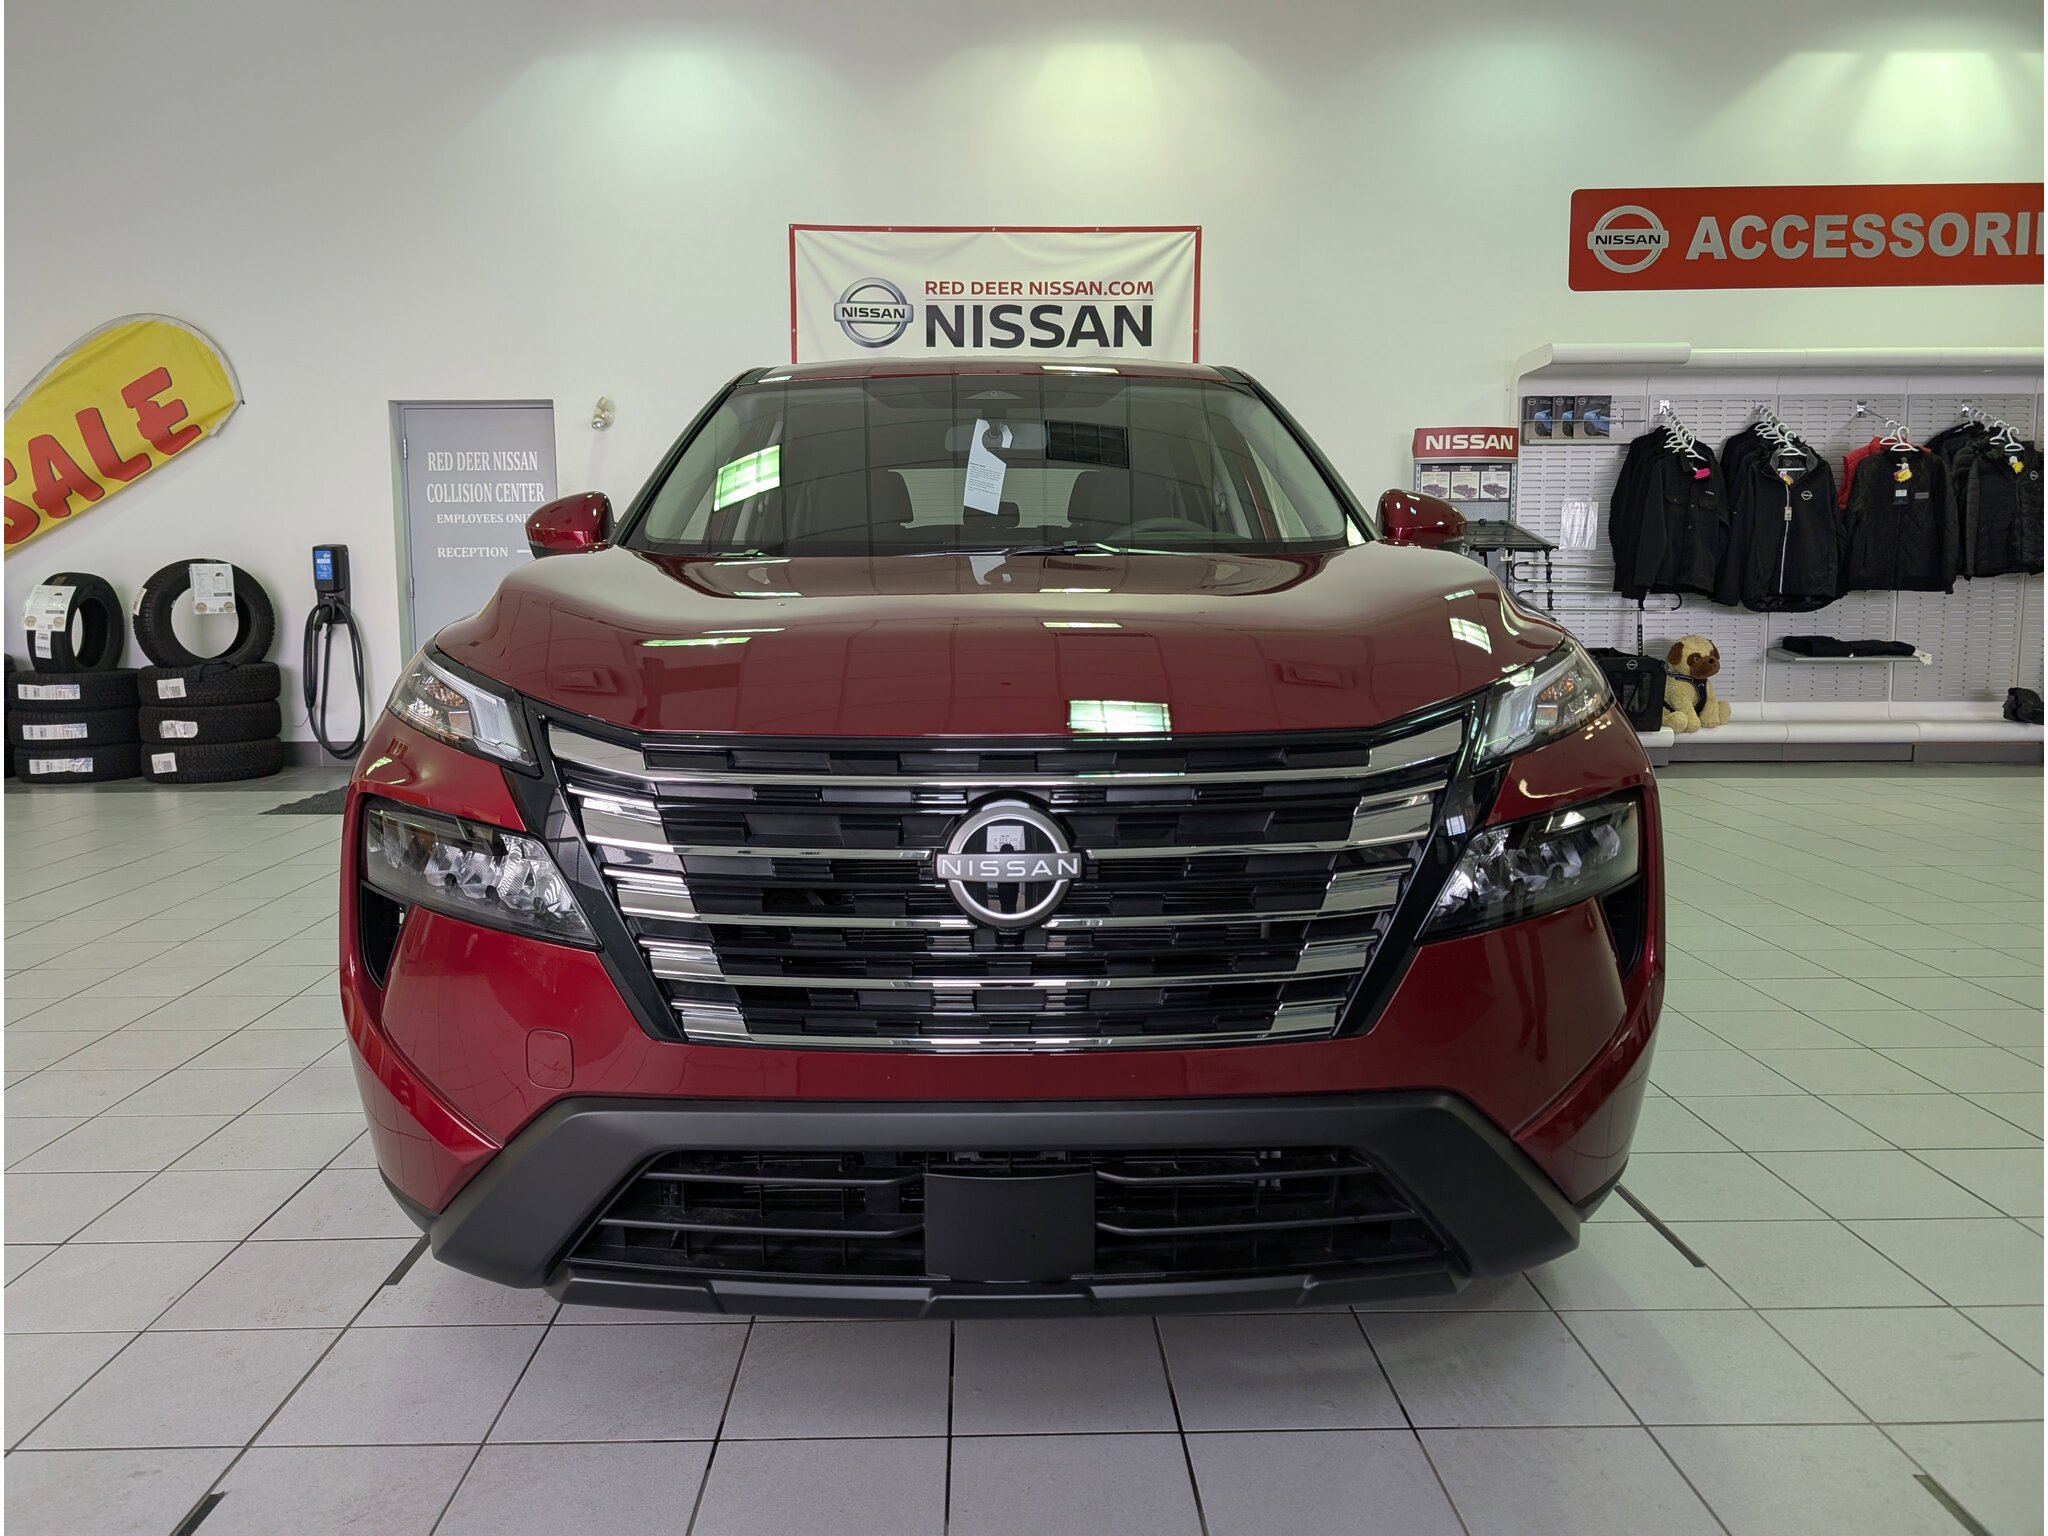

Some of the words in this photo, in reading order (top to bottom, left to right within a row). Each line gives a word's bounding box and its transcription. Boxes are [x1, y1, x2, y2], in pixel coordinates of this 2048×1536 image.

[1595, 233, 1662, 246] NISSAN
[1685, 211, 2044, 260] ACCESSORI
[925, 281, 964, 295] RED
[970, 281, 1023, 295] DEER
[1028, 281, 1154, 296] NISSAN.COM
[841, 306, 906, 319] NISSAN
[925, 304, 1153, 349] NISSAN
[1425, 434, 1513, 450] NISSAN
[427, 452, 453, 472] RED
[457, 452, 491, 471] DEER
[493, 451, 538, 471] NISSAN
[426, 483, 492, 503] COLLISION
[495, 482, 545, 503] CENTER
[436, 513, 503, 524] EMPLOYEES
[437, 546, 508, 558] RECEPTION
[941, 858, 1078, 877] NISSAN
